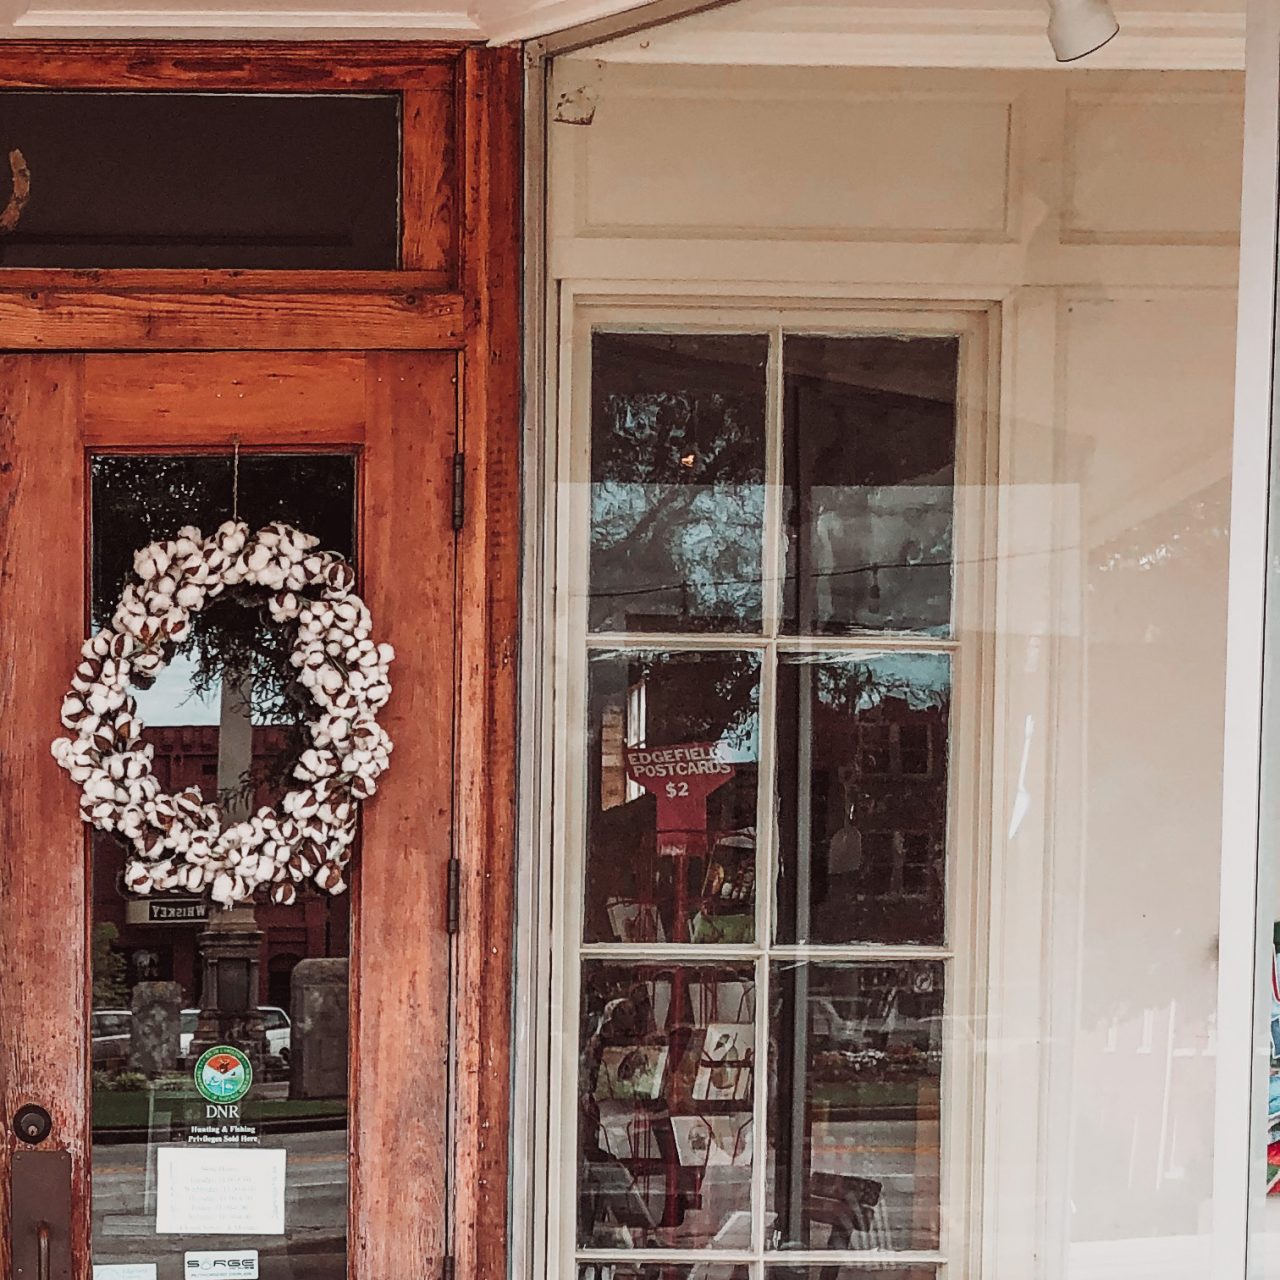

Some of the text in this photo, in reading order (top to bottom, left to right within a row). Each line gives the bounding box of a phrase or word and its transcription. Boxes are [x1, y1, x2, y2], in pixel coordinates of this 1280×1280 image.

[628, 747, 721, 766] EDGEFIELD
[633, 760, 731, 777] POSTCARDS
[666, 781, 689, 798] $2
[206, 1105, 240, 1118] DNR
[191, 1126, 220, 1134] Hunting
[230, 1126, 256, 1134] Fishing
